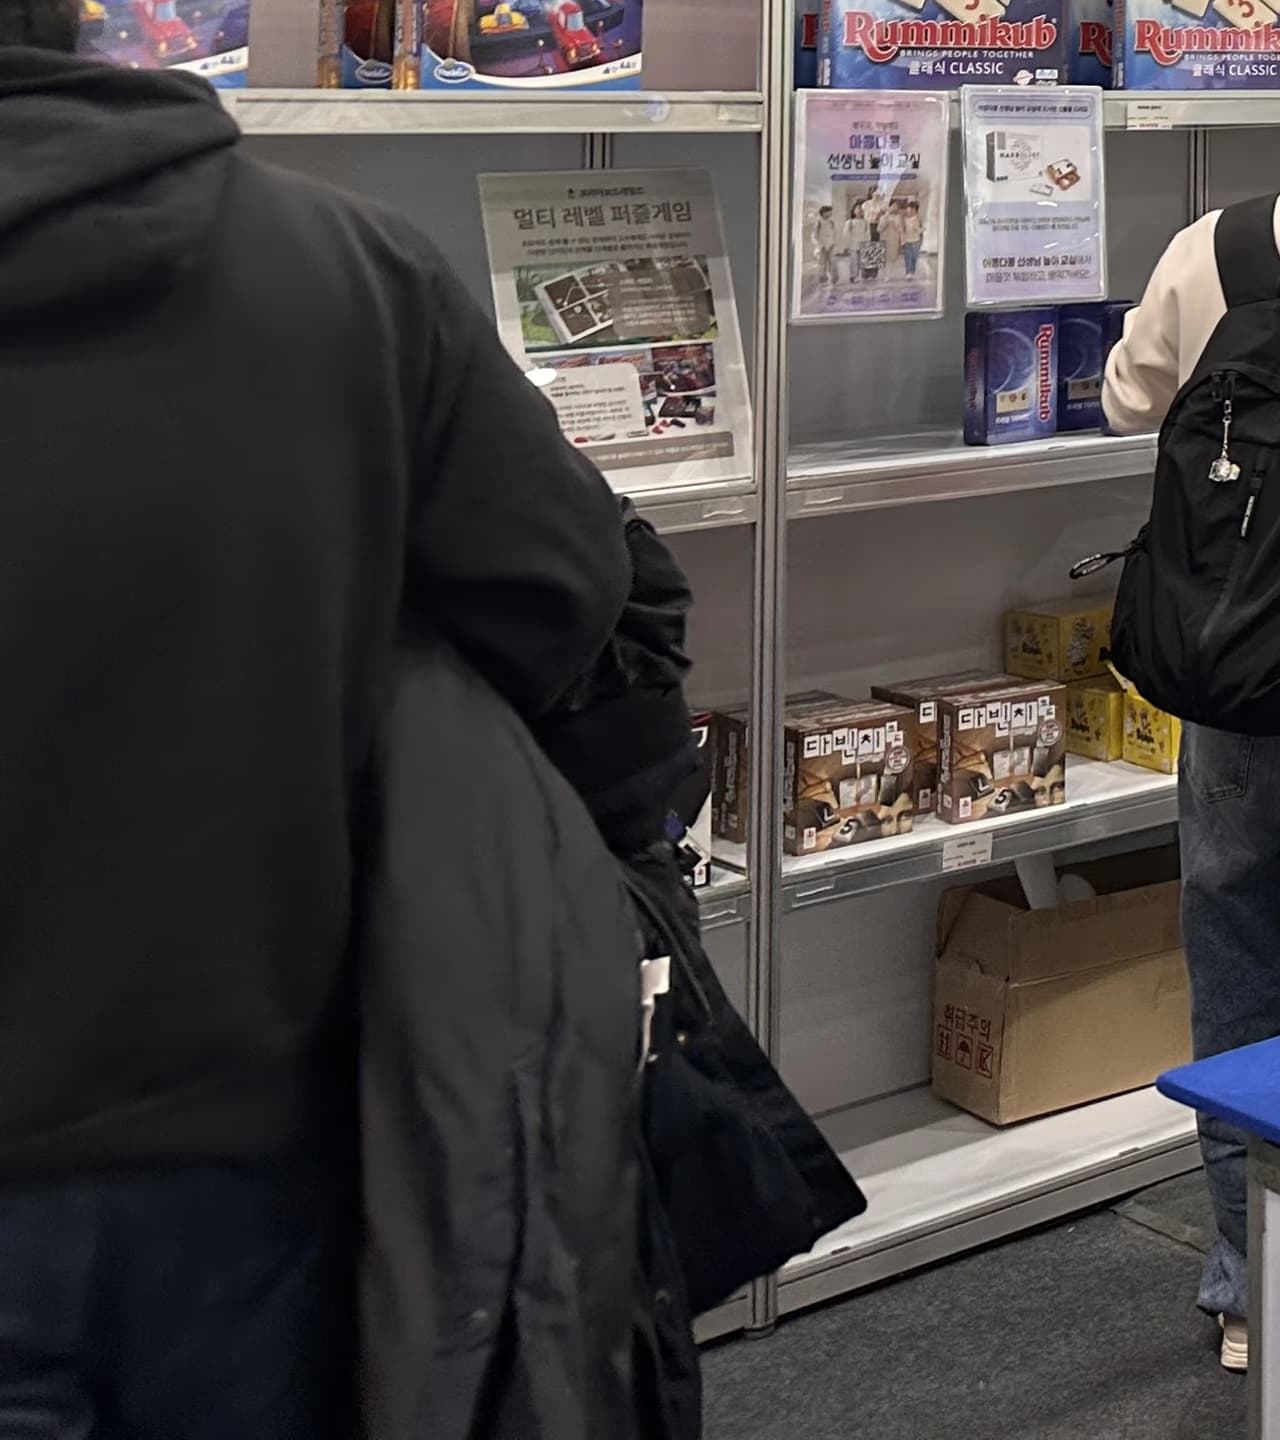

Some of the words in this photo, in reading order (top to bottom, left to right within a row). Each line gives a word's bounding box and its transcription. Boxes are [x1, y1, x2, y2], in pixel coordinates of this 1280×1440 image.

[842, 10, 1058, 62] Rummikub
[900, 49, 939, 58] BRINGS
[941, 50, 979, 59] PEOPLE
[982, 50, 1034, 59] TOGETHER
[908, 62, 946, 76] 클래식
[949, 62, 1005, 75] CLASSIC
[1228, 63, 1278, 77] CLASSIC
[513, 208, 556, 230] 멀티
[563, 205, 605, 227] 레벨
[612, 201, 693, 225] 퍼즐게임
